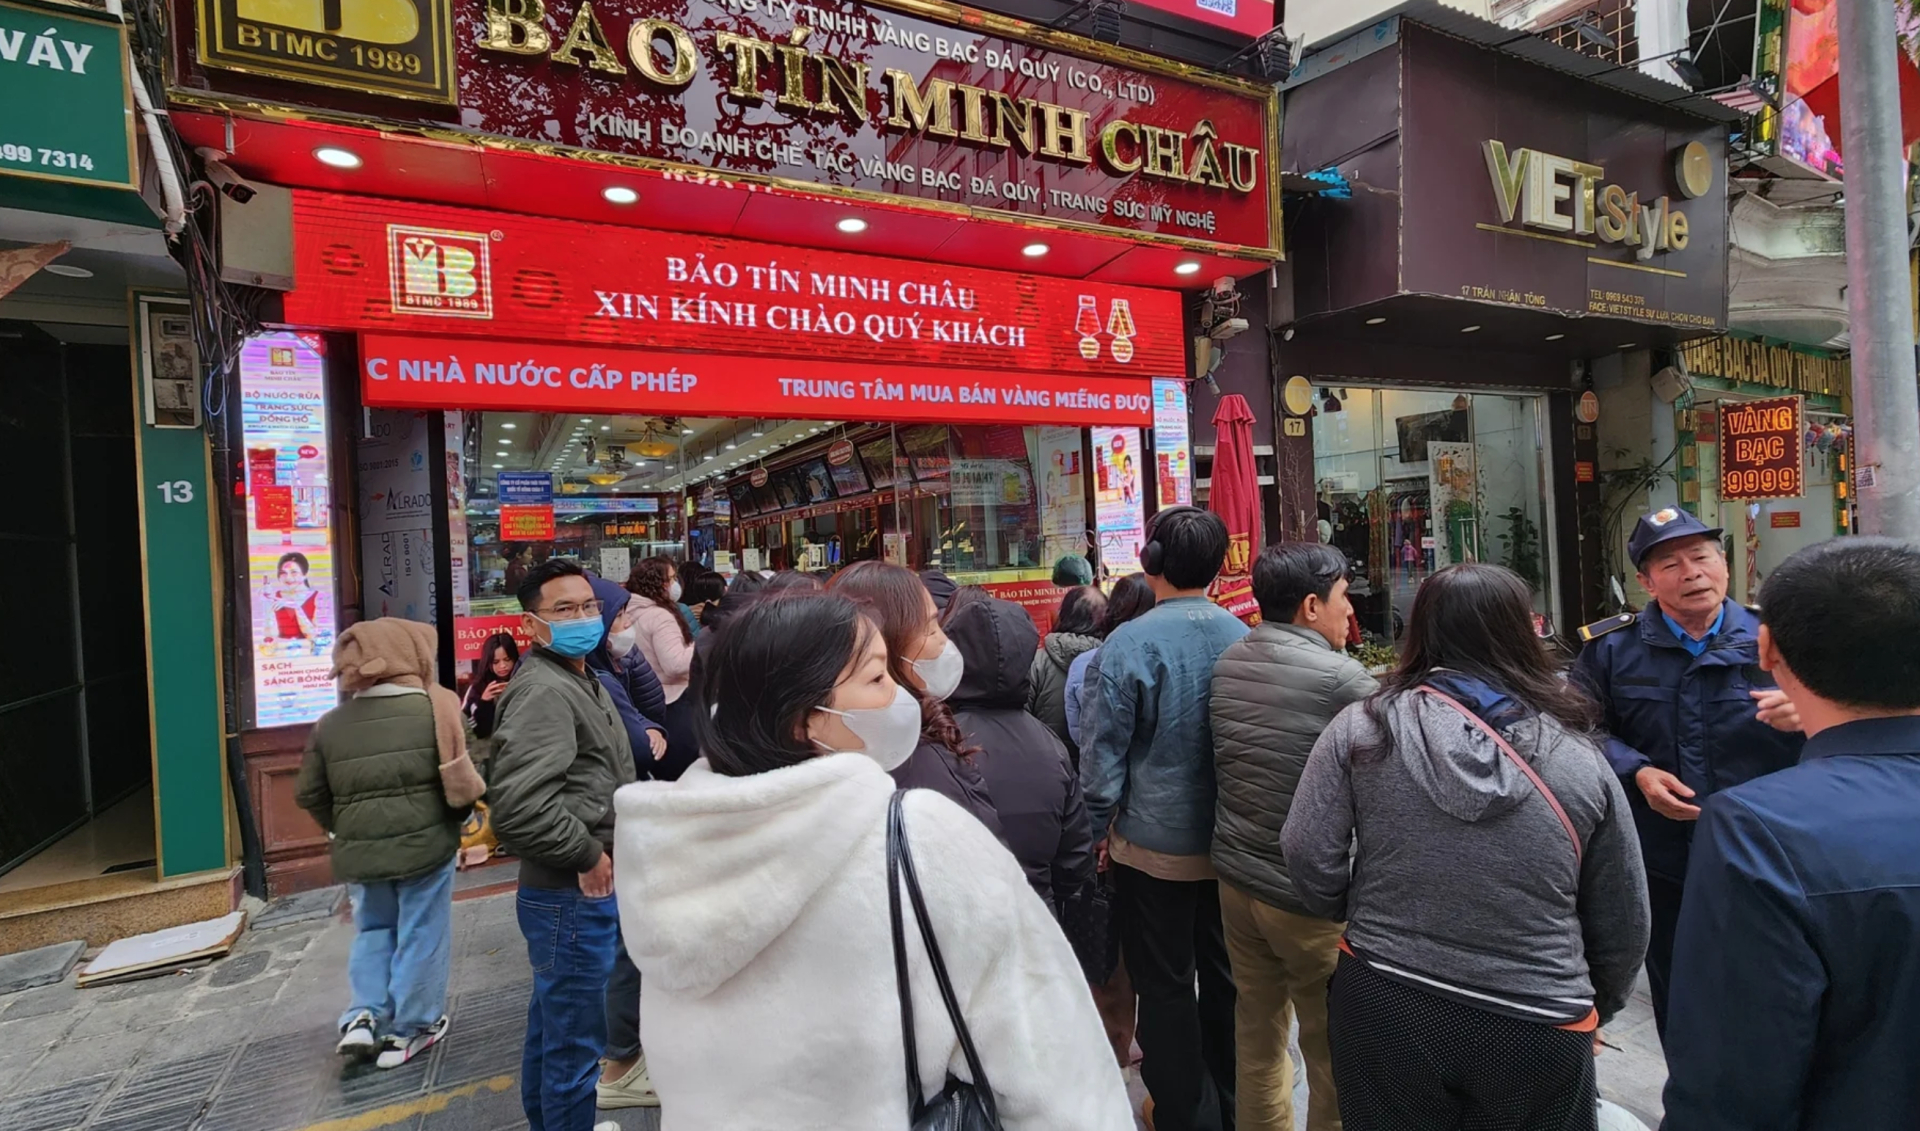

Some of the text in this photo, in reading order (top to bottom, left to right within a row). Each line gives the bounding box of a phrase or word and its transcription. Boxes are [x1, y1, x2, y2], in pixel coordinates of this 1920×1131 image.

[0, 27, 93, 75] VÁY
[237, 22, 421, 75] BTMC 1989
[803, 5, 867, 38] TNHH
[871, 20, 930, 54] VÀNG
[934, 37, 980, 64] BẠC
[984, 45, 1014, 73] ĐÁ
[1019, 57, 1061, 83] QUÝ
[1117, 82, 1156, 107] LTD)
[715, 26, 872, 122] TÍN
[884, 68, 1093, 164] MINH
[1101, 119, 1260, 193] CHÂU
[0, 143, 94, 171] 99 7314
[588, 112, 652, 142] KINH
[660, 123, 750, 158] DOANH
[755, 138, 804, 167] CHẾ
[813, 147, 854, 175] TÁC
[859, 156, 915, 184] VÀNG
[921, 169, 961, 194] BẠC
[970, 174, 998, 198] ĐÁ
[1050, 189, 1107, 214] TRANG
[1113, 199, 1145, 221] SỨC
[1150, 203, 1174, 224] MỸ
[1176, 210, 1216, 235] NGHỆ
[666, 253, 975, 310] BẢO TÍN MINH CHÂU
[1461, 285, 1470, 295] 17
[1524, 291, 1546, 305] TÔNG
[405, 295, 478, 309] BTMC 1989
[594, 290, 1026, 348] XIN KÍNH CHÀO QUÝ KHÁCH
[1723, 335, 1750, 388] BẠC
[245, 390, 261, 399] BỘ
[263, 390, 296, 400] NƯỚC
[399, 355, 467, 384] NHÀ
[475, 360, 562, 389] NƯỚC
[569, 362, 623, 390] CẤP
[630, 366, 698, 394] PHÉP
[778, 378, 855, 400] TRUNG
[859, 377, 904, 402] TÂM
[911, 383, 952, 404] MUA
[958, 381, 997, 405] BÁN
[1001, 382, 1050, 408] VÀNG
[1054, 387, 1111, 410] MIẾNG
[254, 403, 289, 411] TRANG
[259, 414, 309, 423] ĐỒNG HỒ
[1728, 405, 1793, 435] VÀNG
[1289, 421, 1301, 433] 17
[1736, 436, 1784, 466] BẠC
[157, 480, 194, 504] 13
[1727, 467, 1795, 493] 9999
[1019, 588, 1033, 597] TÍN
[1034, 587, 1056, 596] MINH
[457, 627, 487, 639] BẢO
[261, 662, 292, 672] SẠCH
[263, 677, 295, 687] SÁNG
